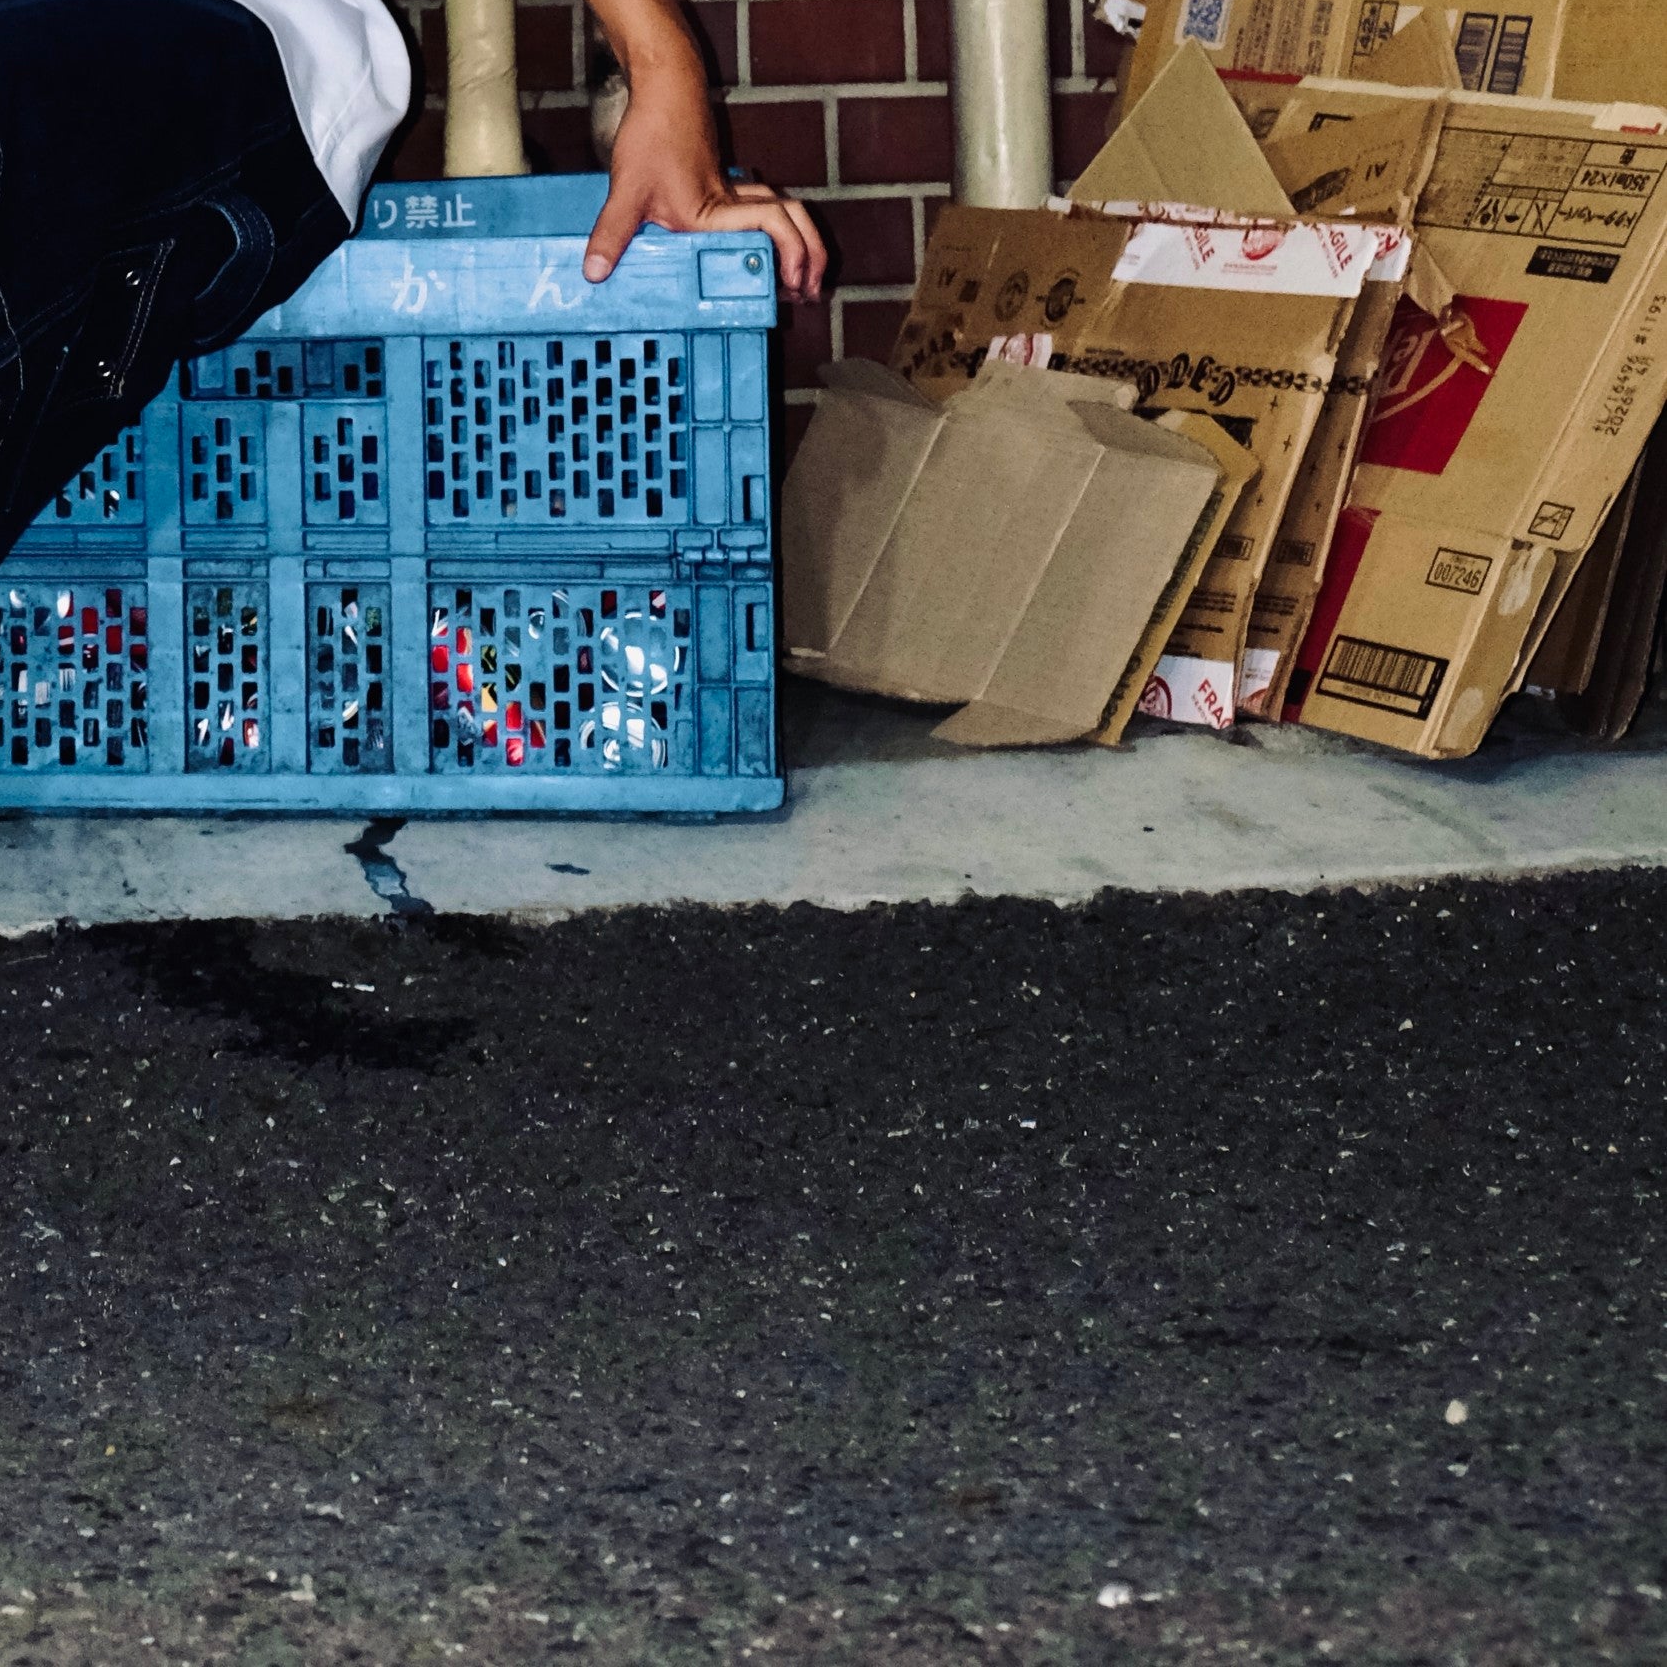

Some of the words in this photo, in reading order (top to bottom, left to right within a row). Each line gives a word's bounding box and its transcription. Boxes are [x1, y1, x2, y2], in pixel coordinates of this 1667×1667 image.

[1194, 225, 1216, 264] GILE
[1329, 229, 1353, 272] GILE
[1433, 562, 1482, 589] 007246
